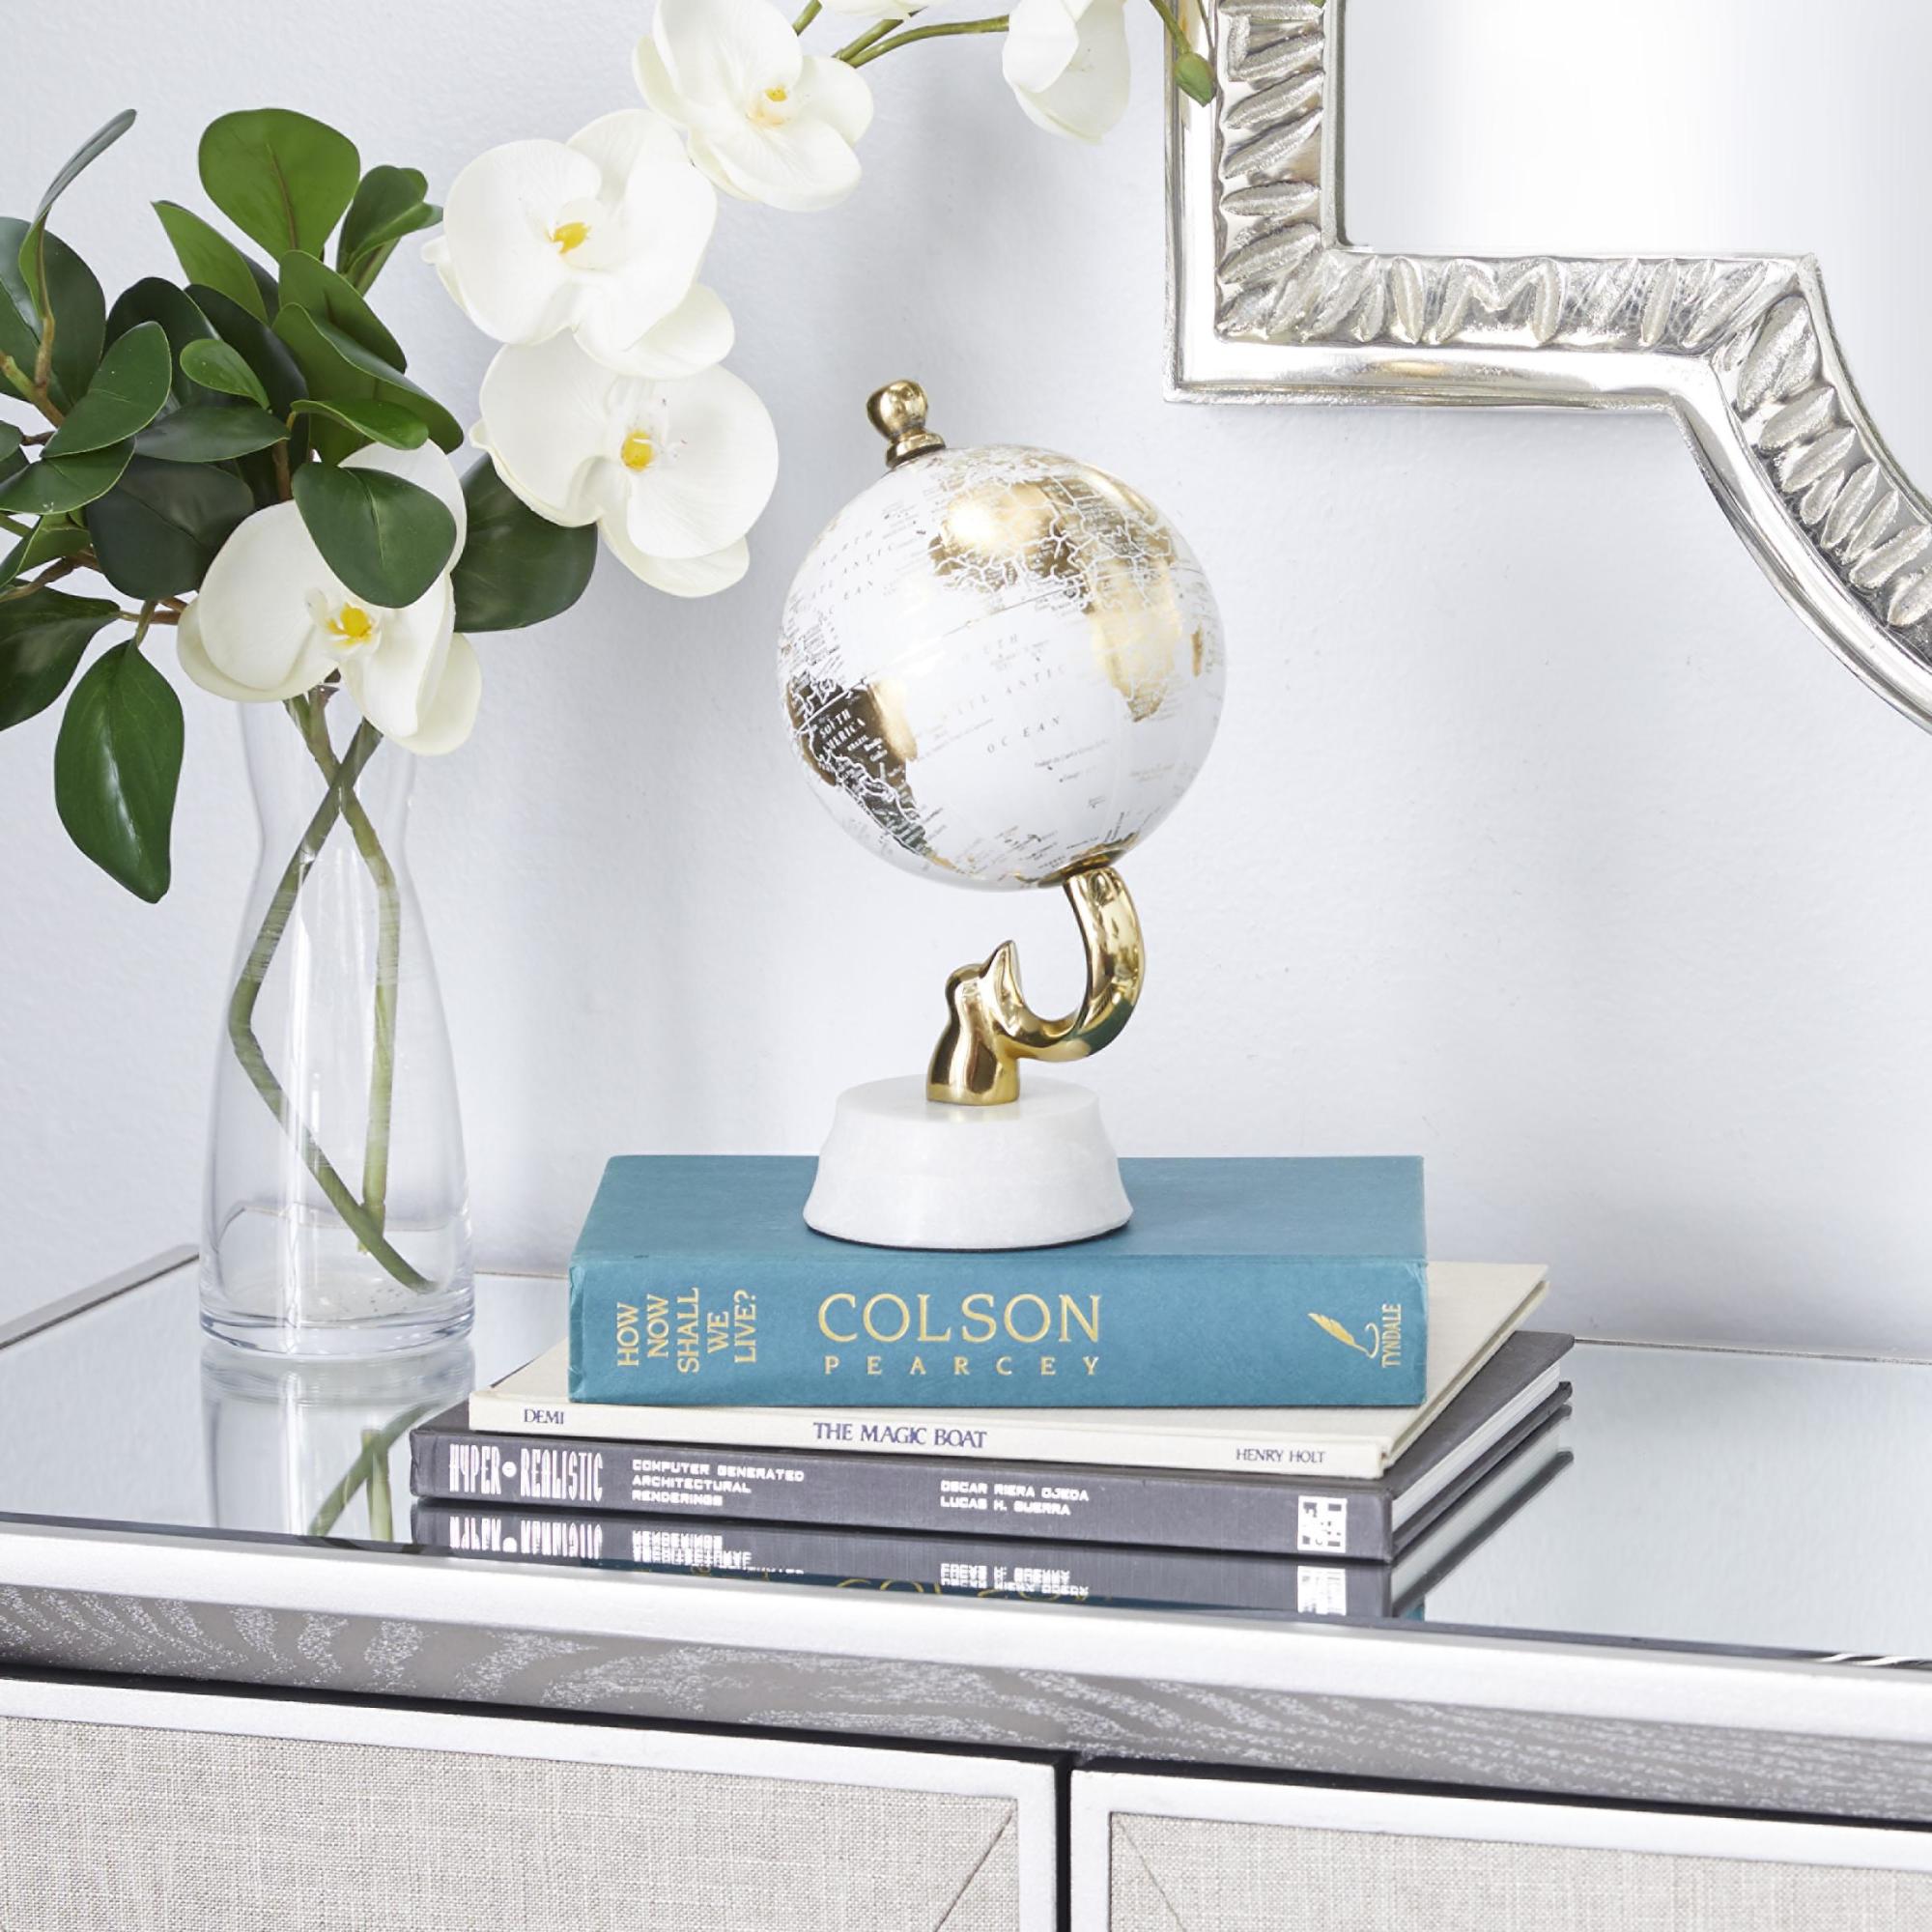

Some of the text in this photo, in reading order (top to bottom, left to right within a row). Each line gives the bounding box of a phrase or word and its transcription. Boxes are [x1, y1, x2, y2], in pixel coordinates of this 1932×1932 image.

[646, 1293, 669, 1358] NOW
[676, 1287, 699, 1374] SHALL
[706, 1310, 729, 1354] WE
[733, 1289, 756, 1363] LIVE?
[818, 1293, 1101, 1343] COLSON
[616, 1301, 640, 1367] HOW
[1381, 1302, 1402, 1369] TYNDALE
[824, 1355, 1100, 1376] PEARCEY
[524, 1407, 565, 1426] DEMI
[813, 1421, 987, 1449] THE MAGIC BOAT
[1236, 1448, 1326, 1463] HENRY HOLT
[449, 1443, 604, 1502] HYPER REALISTIC
[632, 1459, 805, 1482] COMPUTER GENERATED
[632, 1474, 753, 1494] ARCHITECTURAL
[632, 1489, 724, 1507] RENDERINGS
[940, 1479, 1090, 1502] OSCAR RIERA OJEDA
[940, 1495, 988, 1511] LUCAS
[1012, 1500, 1071, 1517] GUERRA
